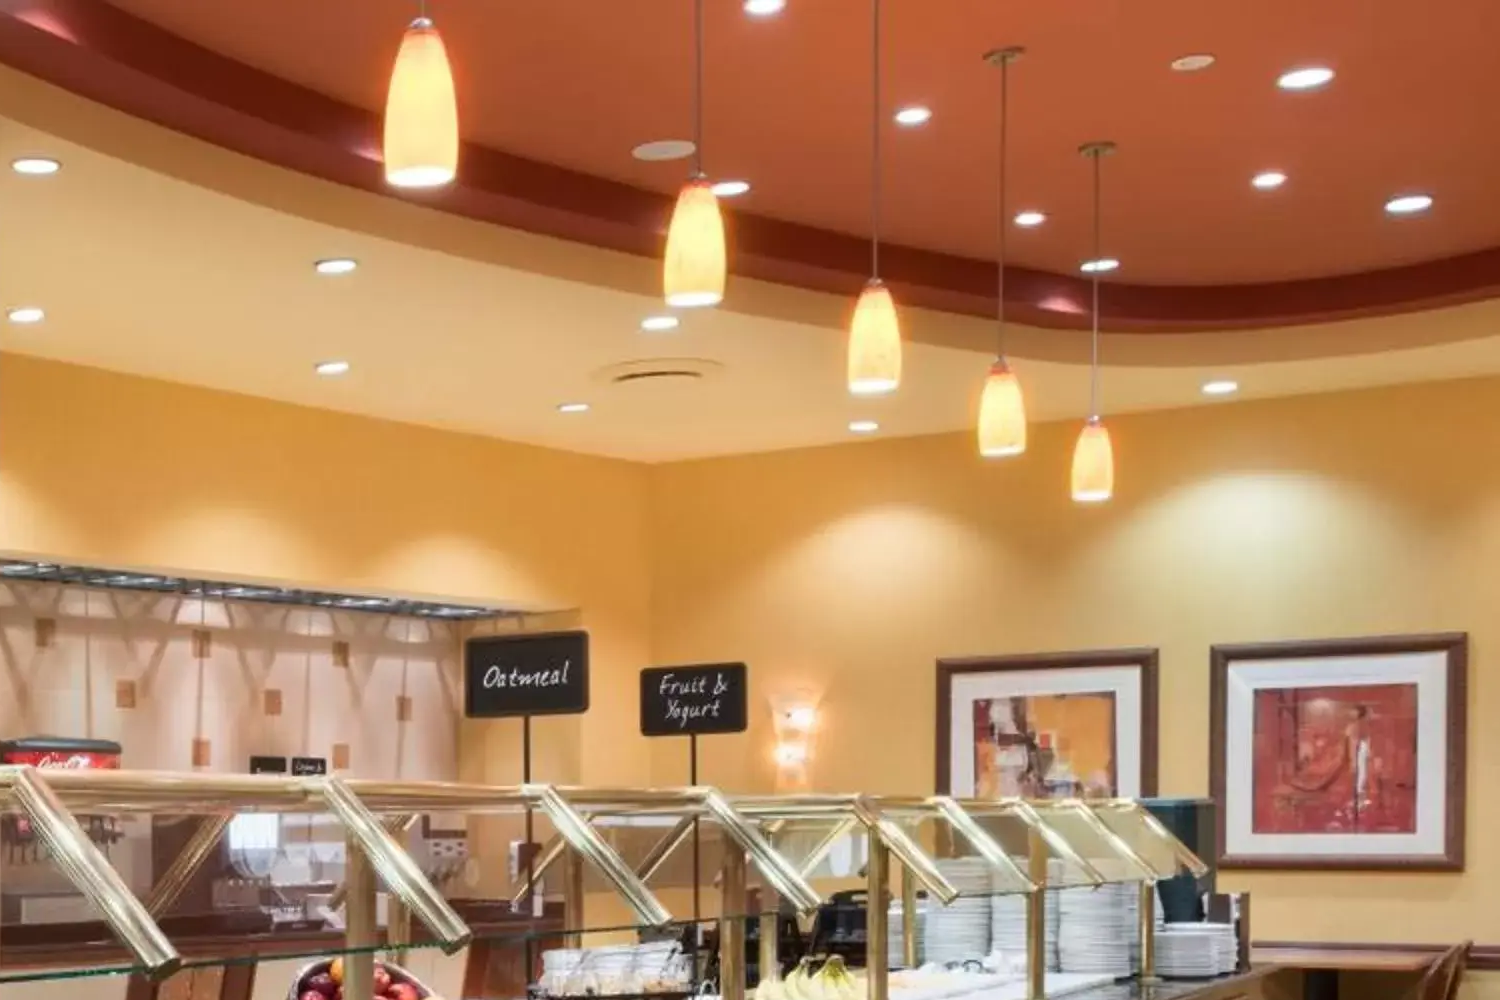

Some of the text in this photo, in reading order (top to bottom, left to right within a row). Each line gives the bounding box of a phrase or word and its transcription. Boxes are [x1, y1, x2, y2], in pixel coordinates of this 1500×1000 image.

[483, 659, 570, 689] Oatmeal
[659, 672, 729, 695] Fruit &
[664, 698, 720, 729] Yogurt
